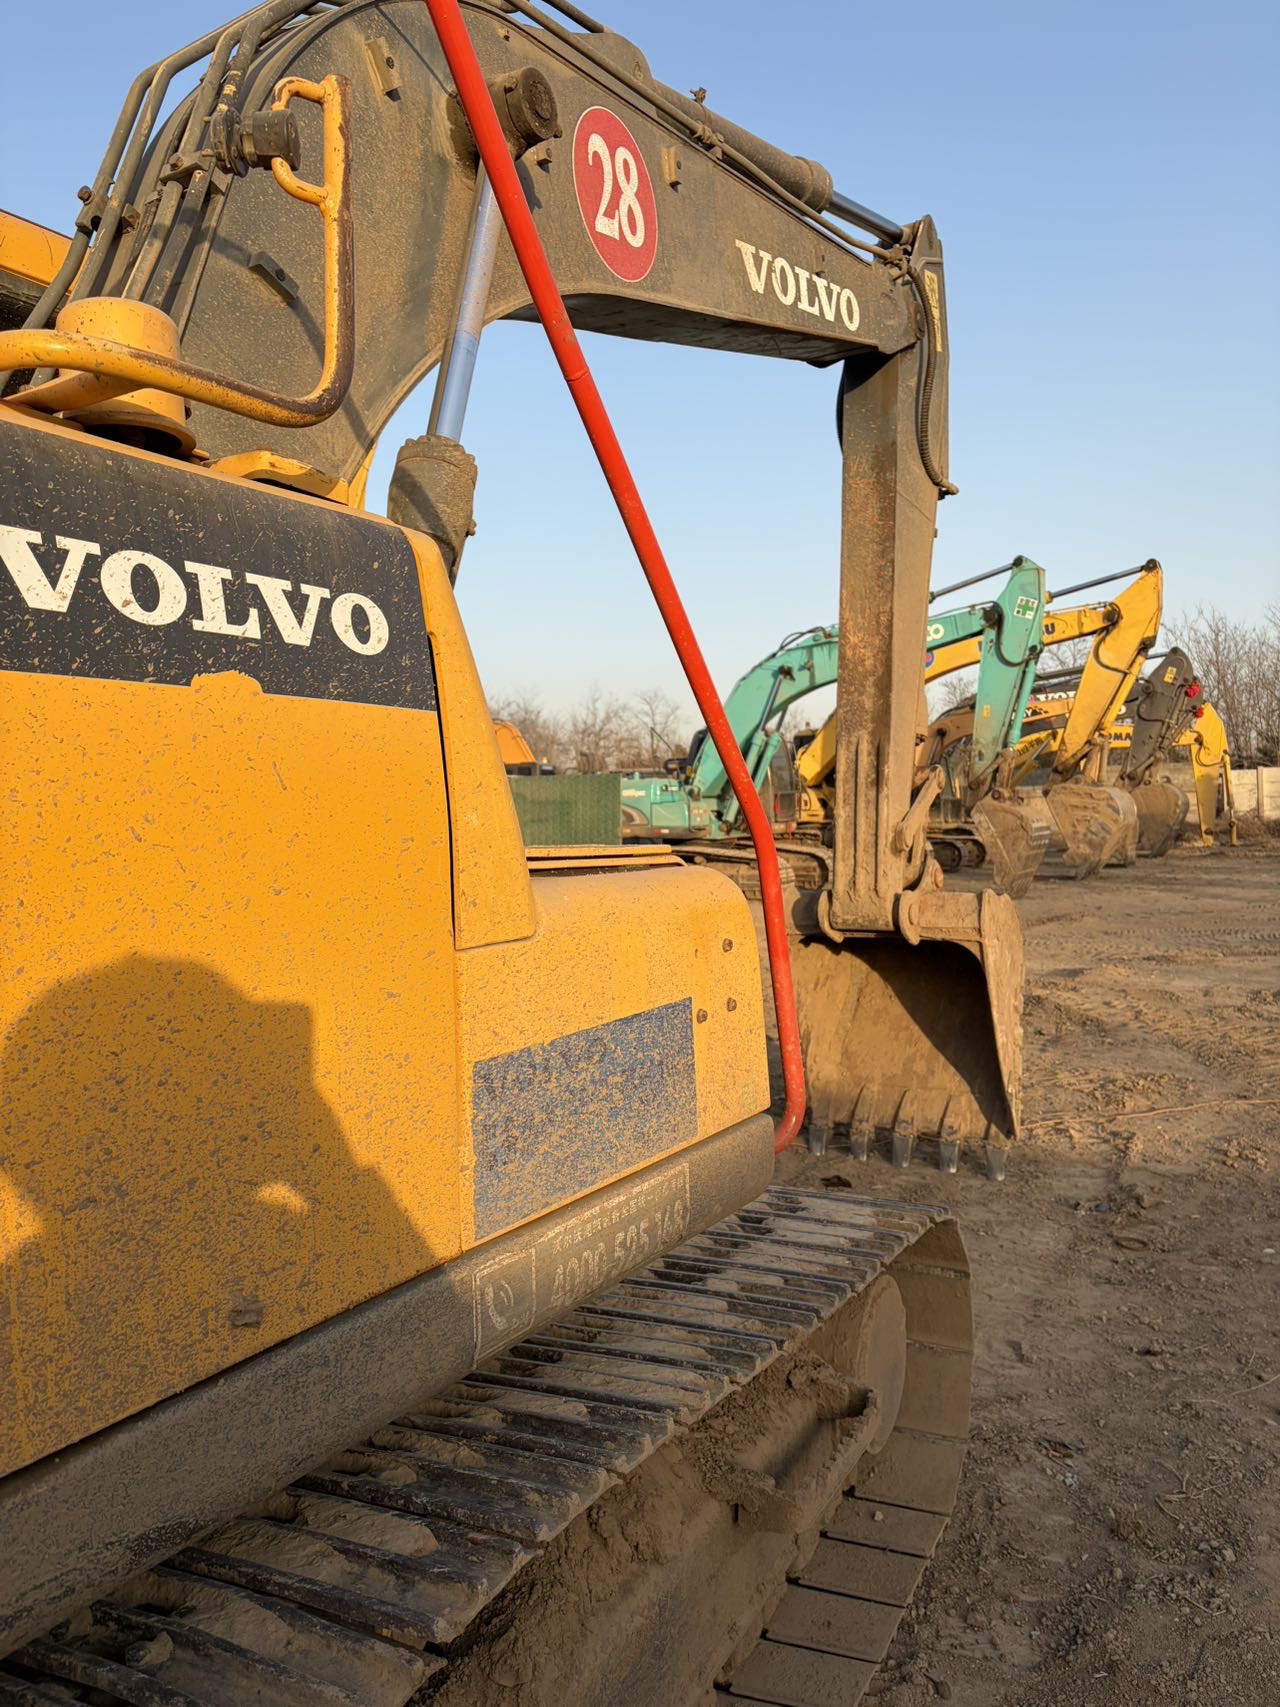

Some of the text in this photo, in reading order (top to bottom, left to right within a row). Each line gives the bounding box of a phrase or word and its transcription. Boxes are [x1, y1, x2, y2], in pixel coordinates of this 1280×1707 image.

[587, 133, 646, 249] 28
[735, 238, 861, 332] VOLVO
[0, 524, 390, 656] VOLVO
